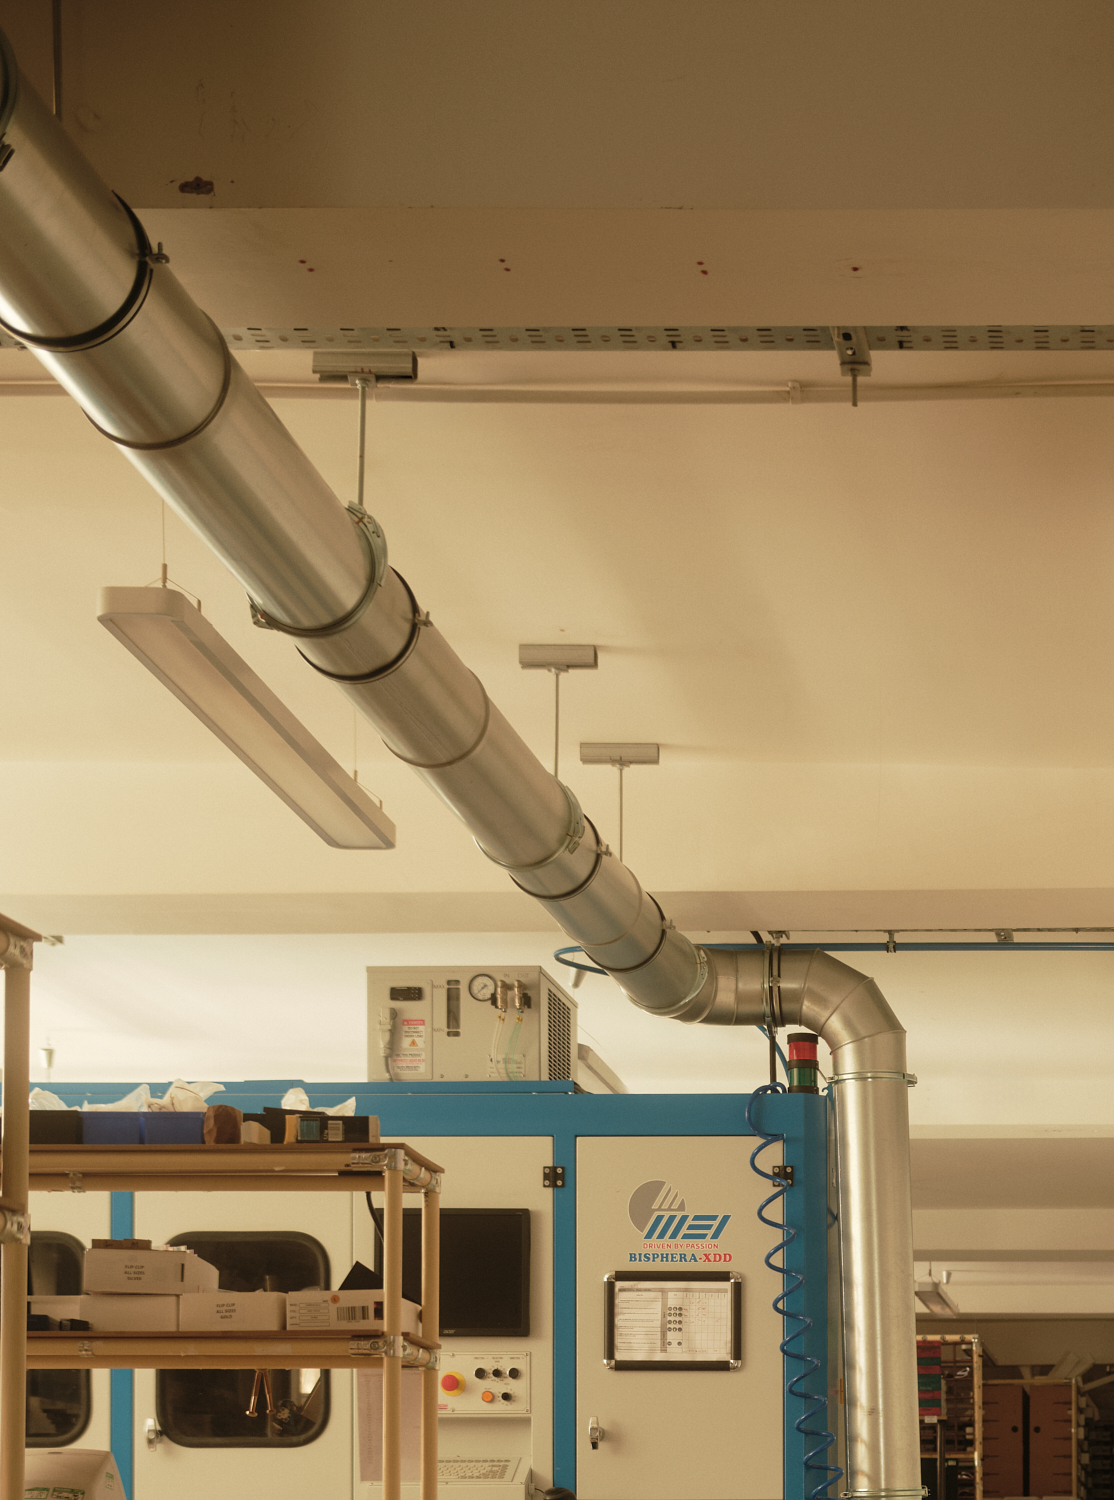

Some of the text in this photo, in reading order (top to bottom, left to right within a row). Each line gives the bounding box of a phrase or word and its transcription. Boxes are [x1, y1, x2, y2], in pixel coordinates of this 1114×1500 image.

[642, 1242, 719, 1250] DRIVEN BY PASSION
[628, 1252, 733, 1263] BISPHERA-XDD
